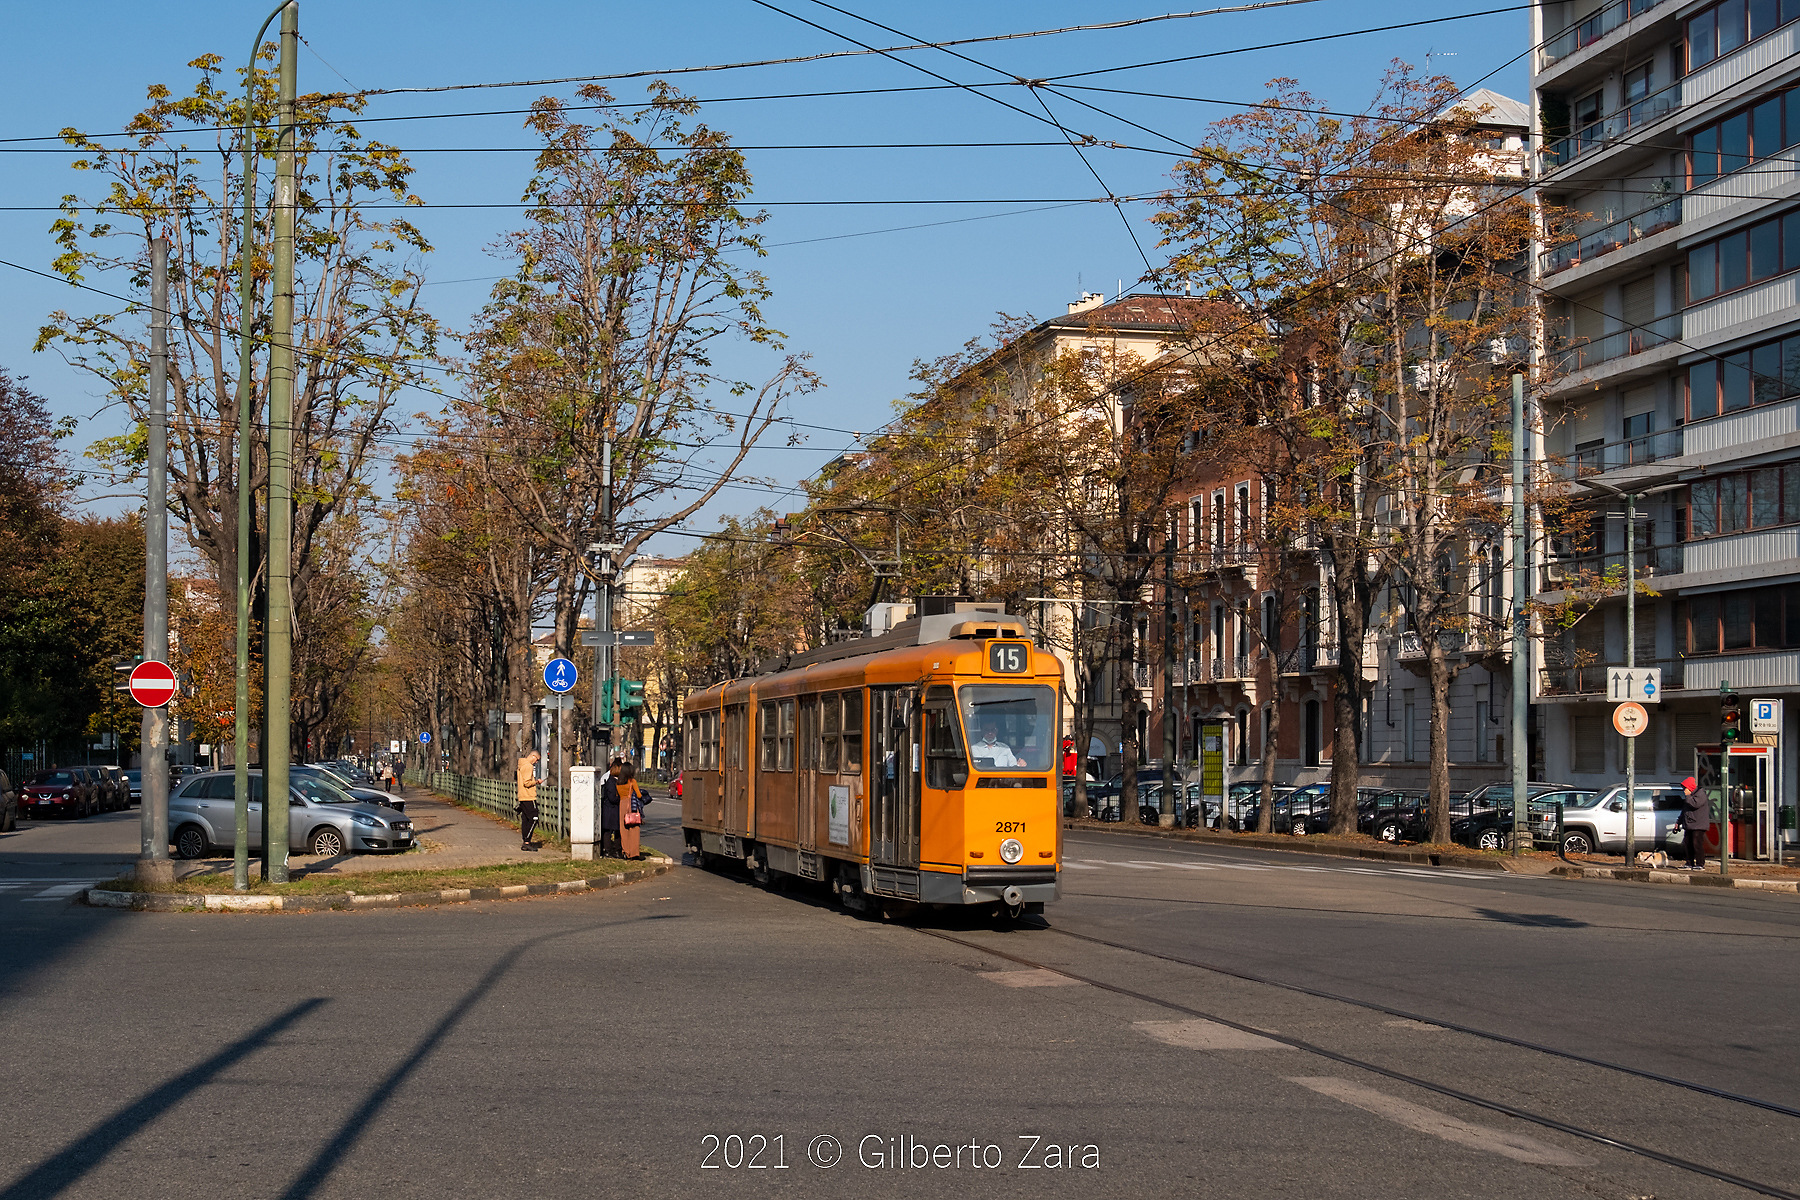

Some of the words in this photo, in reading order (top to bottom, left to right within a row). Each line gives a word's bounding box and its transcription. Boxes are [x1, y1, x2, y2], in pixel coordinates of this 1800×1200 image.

[997, 648, 1019, 670] 15
[1761, 705, 1769, 717] P
[995, 821, 1026, 833] 2871
